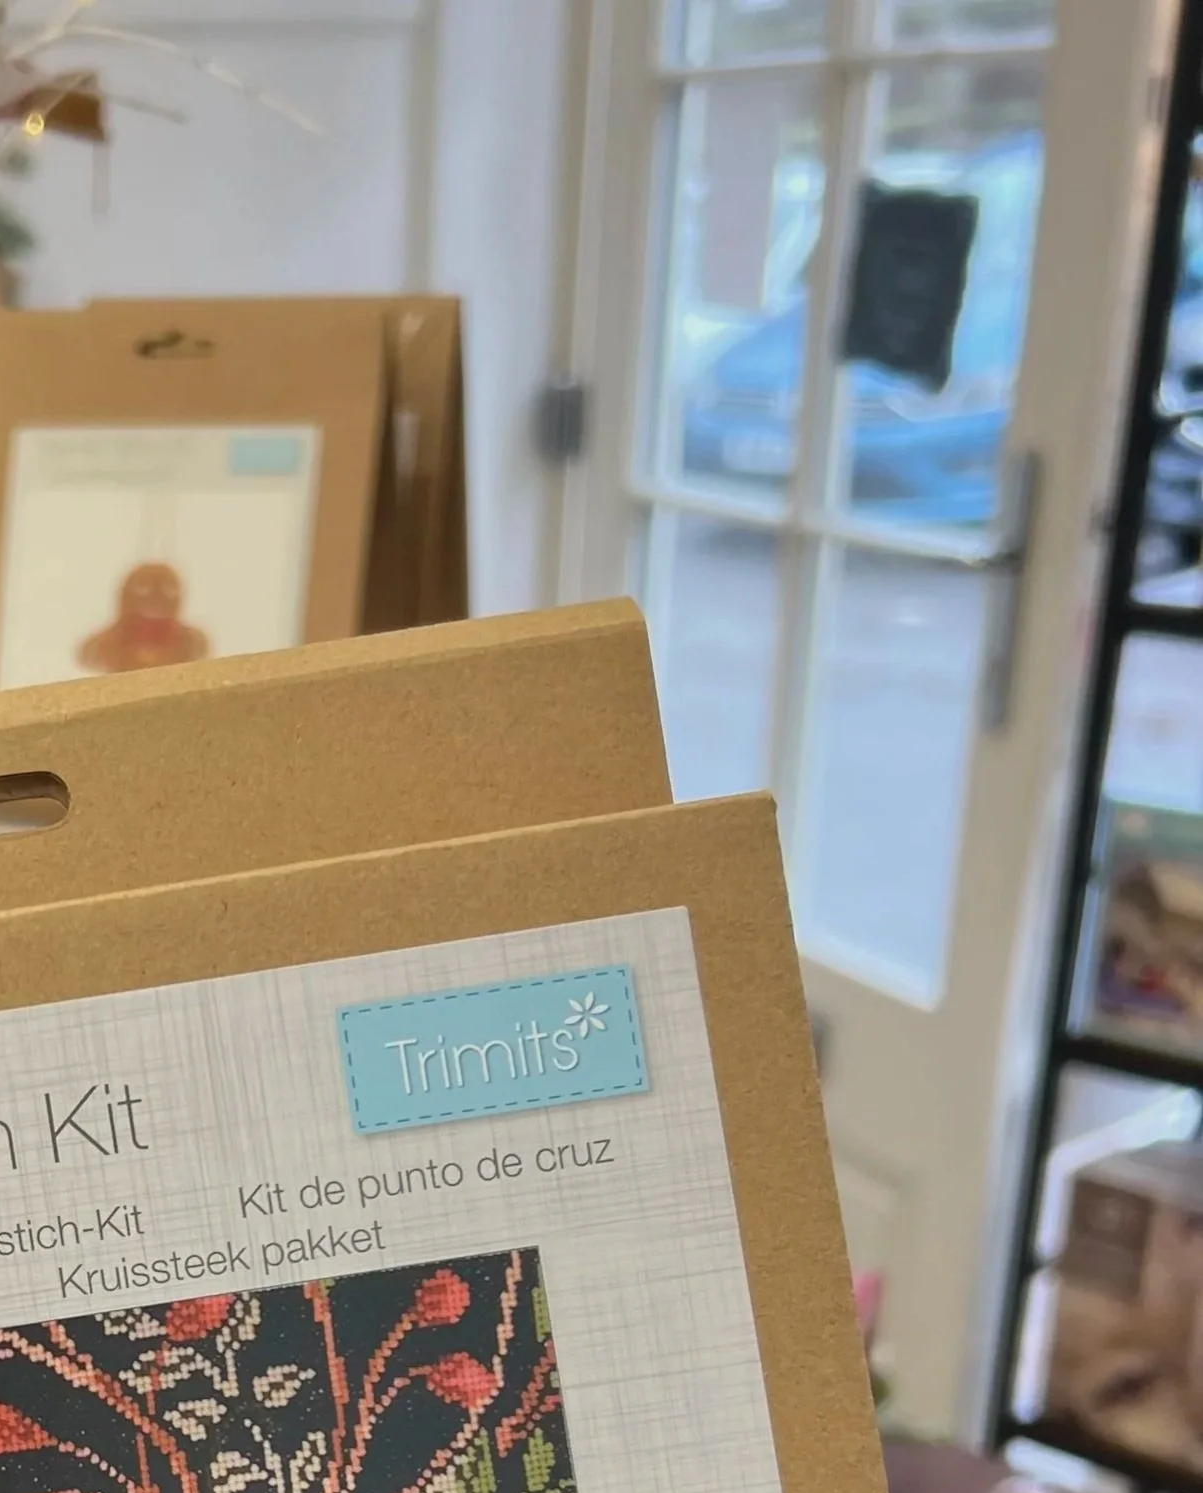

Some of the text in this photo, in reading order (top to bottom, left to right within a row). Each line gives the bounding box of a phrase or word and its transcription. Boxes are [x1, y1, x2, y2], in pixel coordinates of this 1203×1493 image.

[385, 1018, 579, 1093] Trimits
[44, 1084, 149, 1163] Kit
[239, 1139, 614, 1218] Kit de punto de cruz
[58, 1220, 387, 1299] Kruissteek pakket
